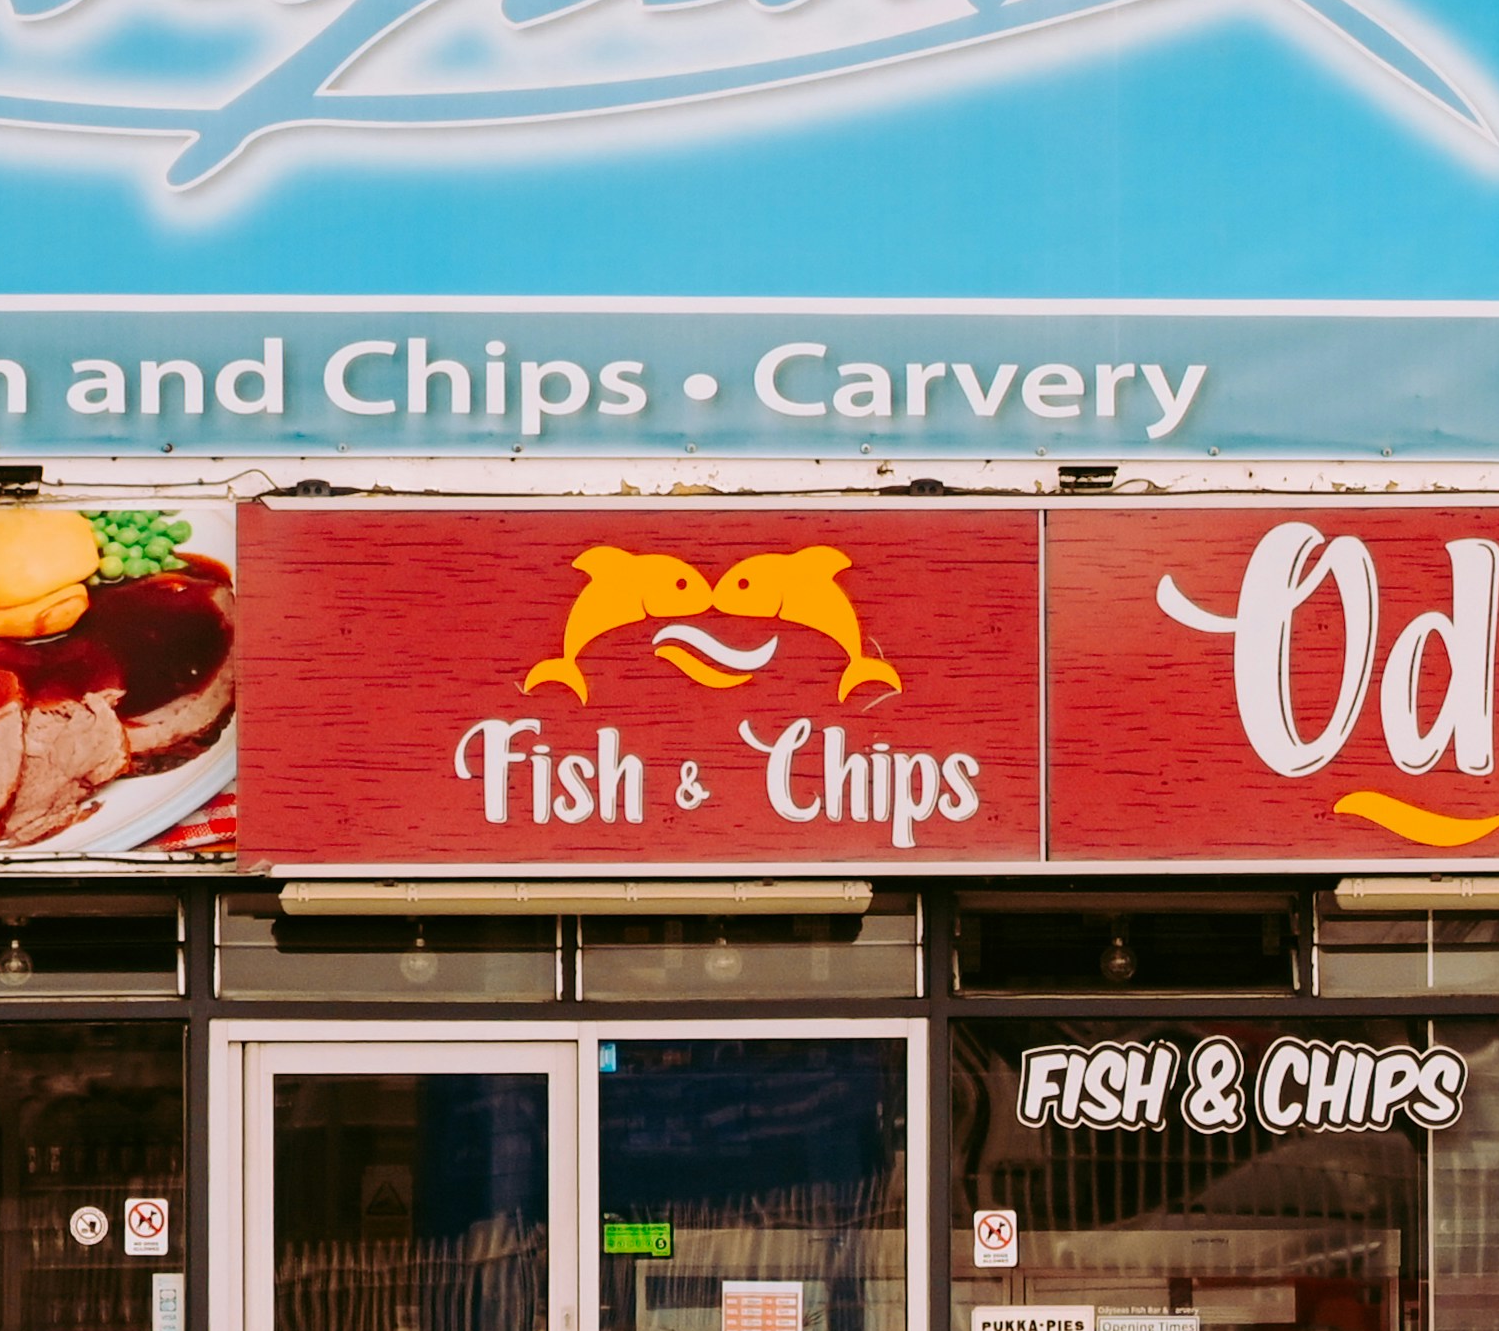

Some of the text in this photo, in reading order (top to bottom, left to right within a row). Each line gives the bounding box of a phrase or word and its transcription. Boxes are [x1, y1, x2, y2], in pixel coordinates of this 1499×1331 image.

[66, 338, 284, 418] and
[323, 338, 648, 435] Chips
[753, 343, 1207, 439] Carvery
[454, 718, 980, 849] Fish & Chips
[1020, 1039, 1464, 1130] FISH & CHIPS
[1158, 1322, 1194, 1331] Times
